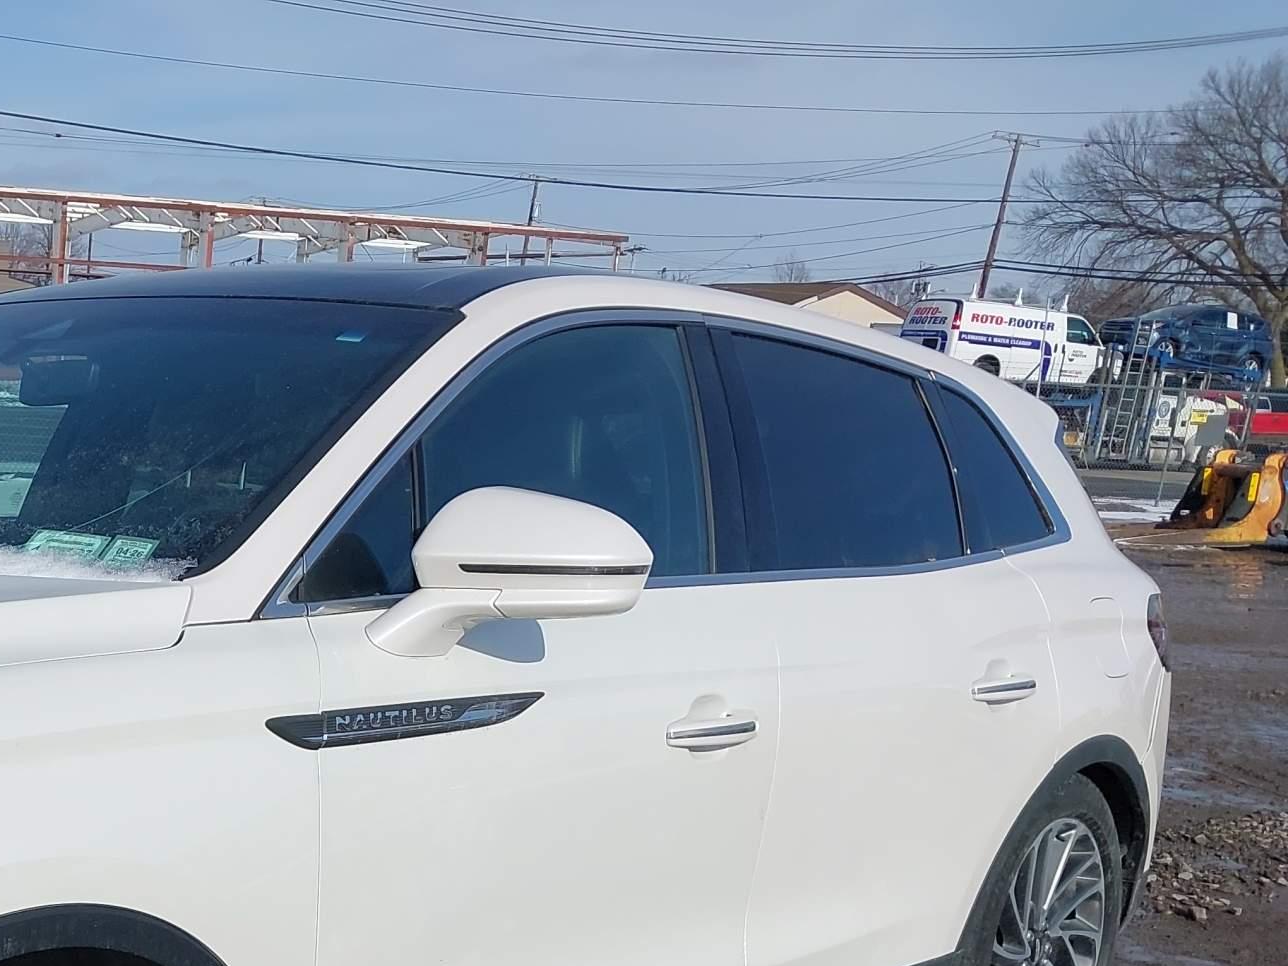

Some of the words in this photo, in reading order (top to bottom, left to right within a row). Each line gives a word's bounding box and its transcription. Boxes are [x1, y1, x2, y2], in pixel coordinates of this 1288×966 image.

[914, 306, 942, 315] ROTO-
[909, 316, 948, 325] ROOTER
[971, 313, 1055, 331] ROTO-ROOTER
[335, 704, 455, 732] NAUTILUS
